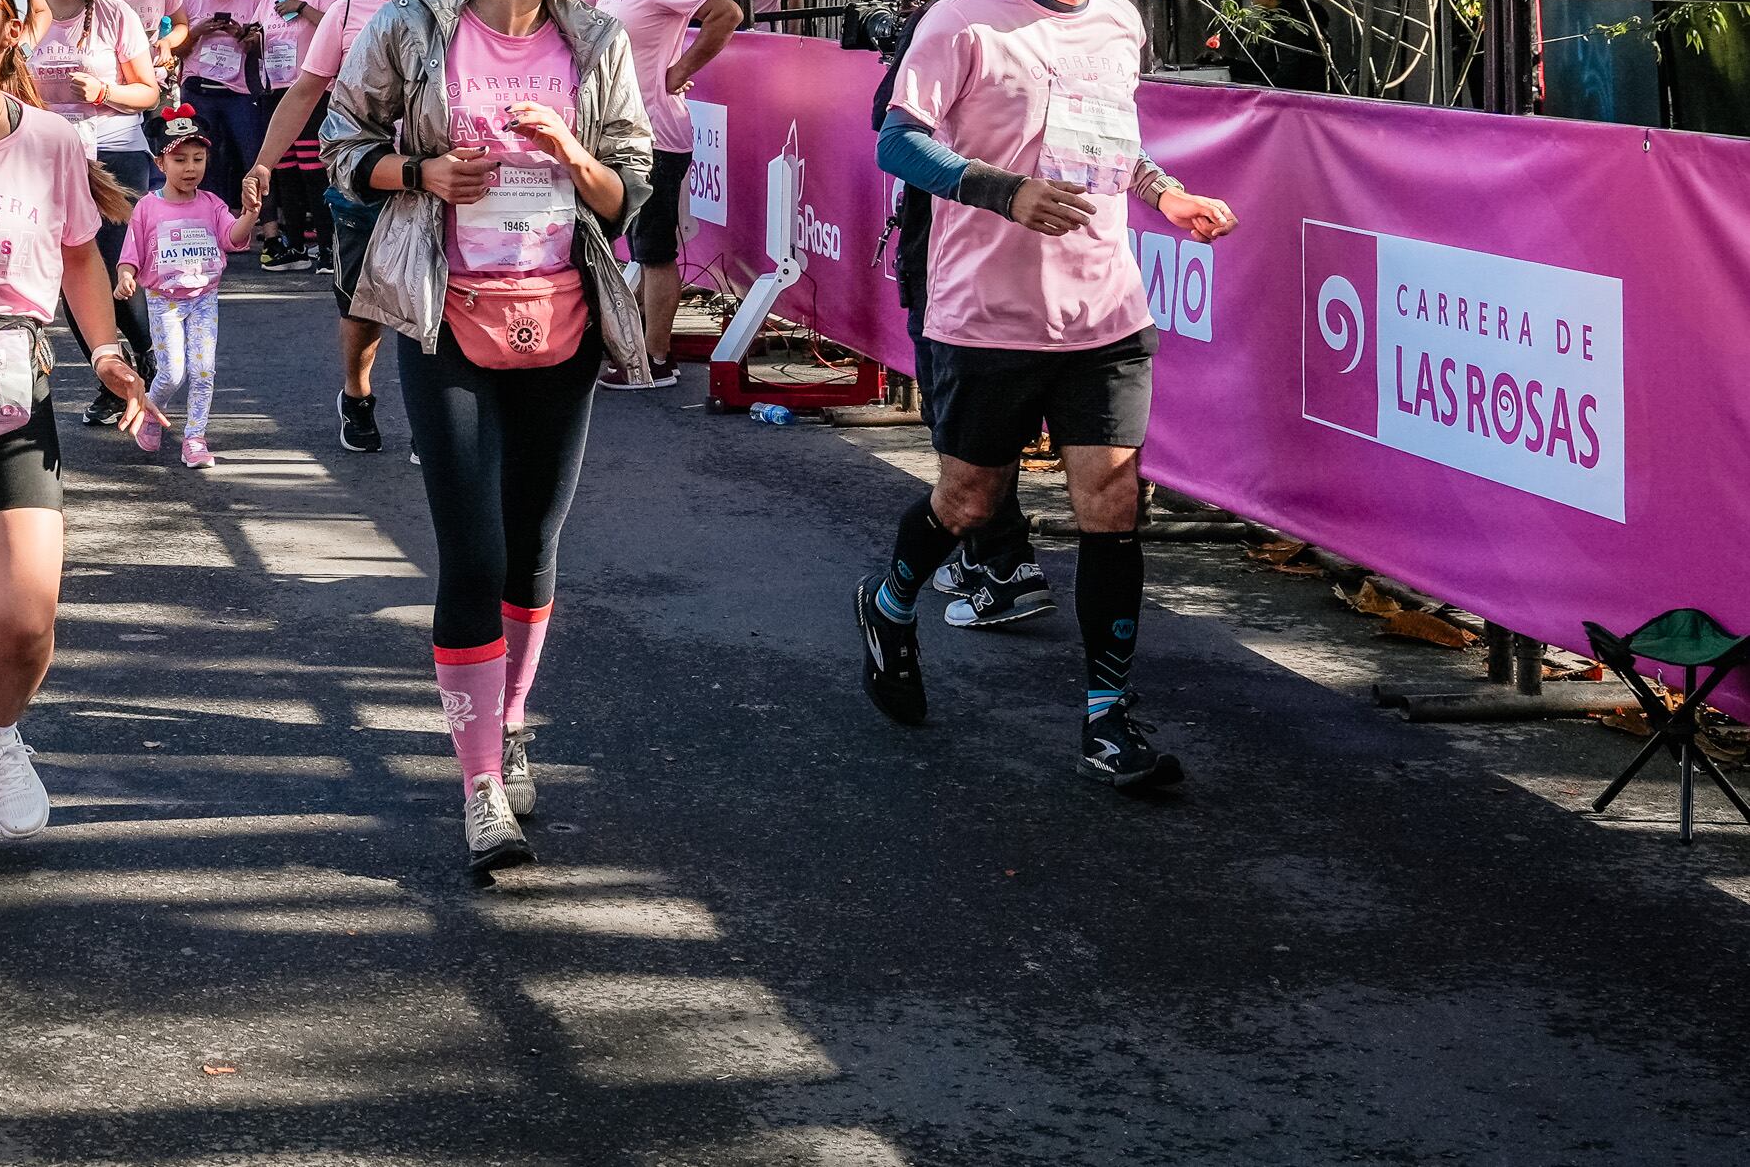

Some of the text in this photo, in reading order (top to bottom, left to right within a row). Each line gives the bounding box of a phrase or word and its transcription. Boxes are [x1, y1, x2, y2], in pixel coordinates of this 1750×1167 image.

[446, 76, 578, 99] CARRERA
[495, 92, 538, 102] DE LAS
[707, 130, 720, 149] DE
[504, 176, 550, 185] LAS ROSAS
[689, 159, 721, 203] OSAS
[518, 190, 535, 198] alma
[503, 220, 530, 232] 19465
[797, 204, 841, 261] aRosa
[161, 249, 178, 259] LAS
[510, 318, 539, 333] KIPLING
[1396, 283, 1595, 362] CARRERA DE
[1395, 345, 1601, 470] LAS ROSAS
